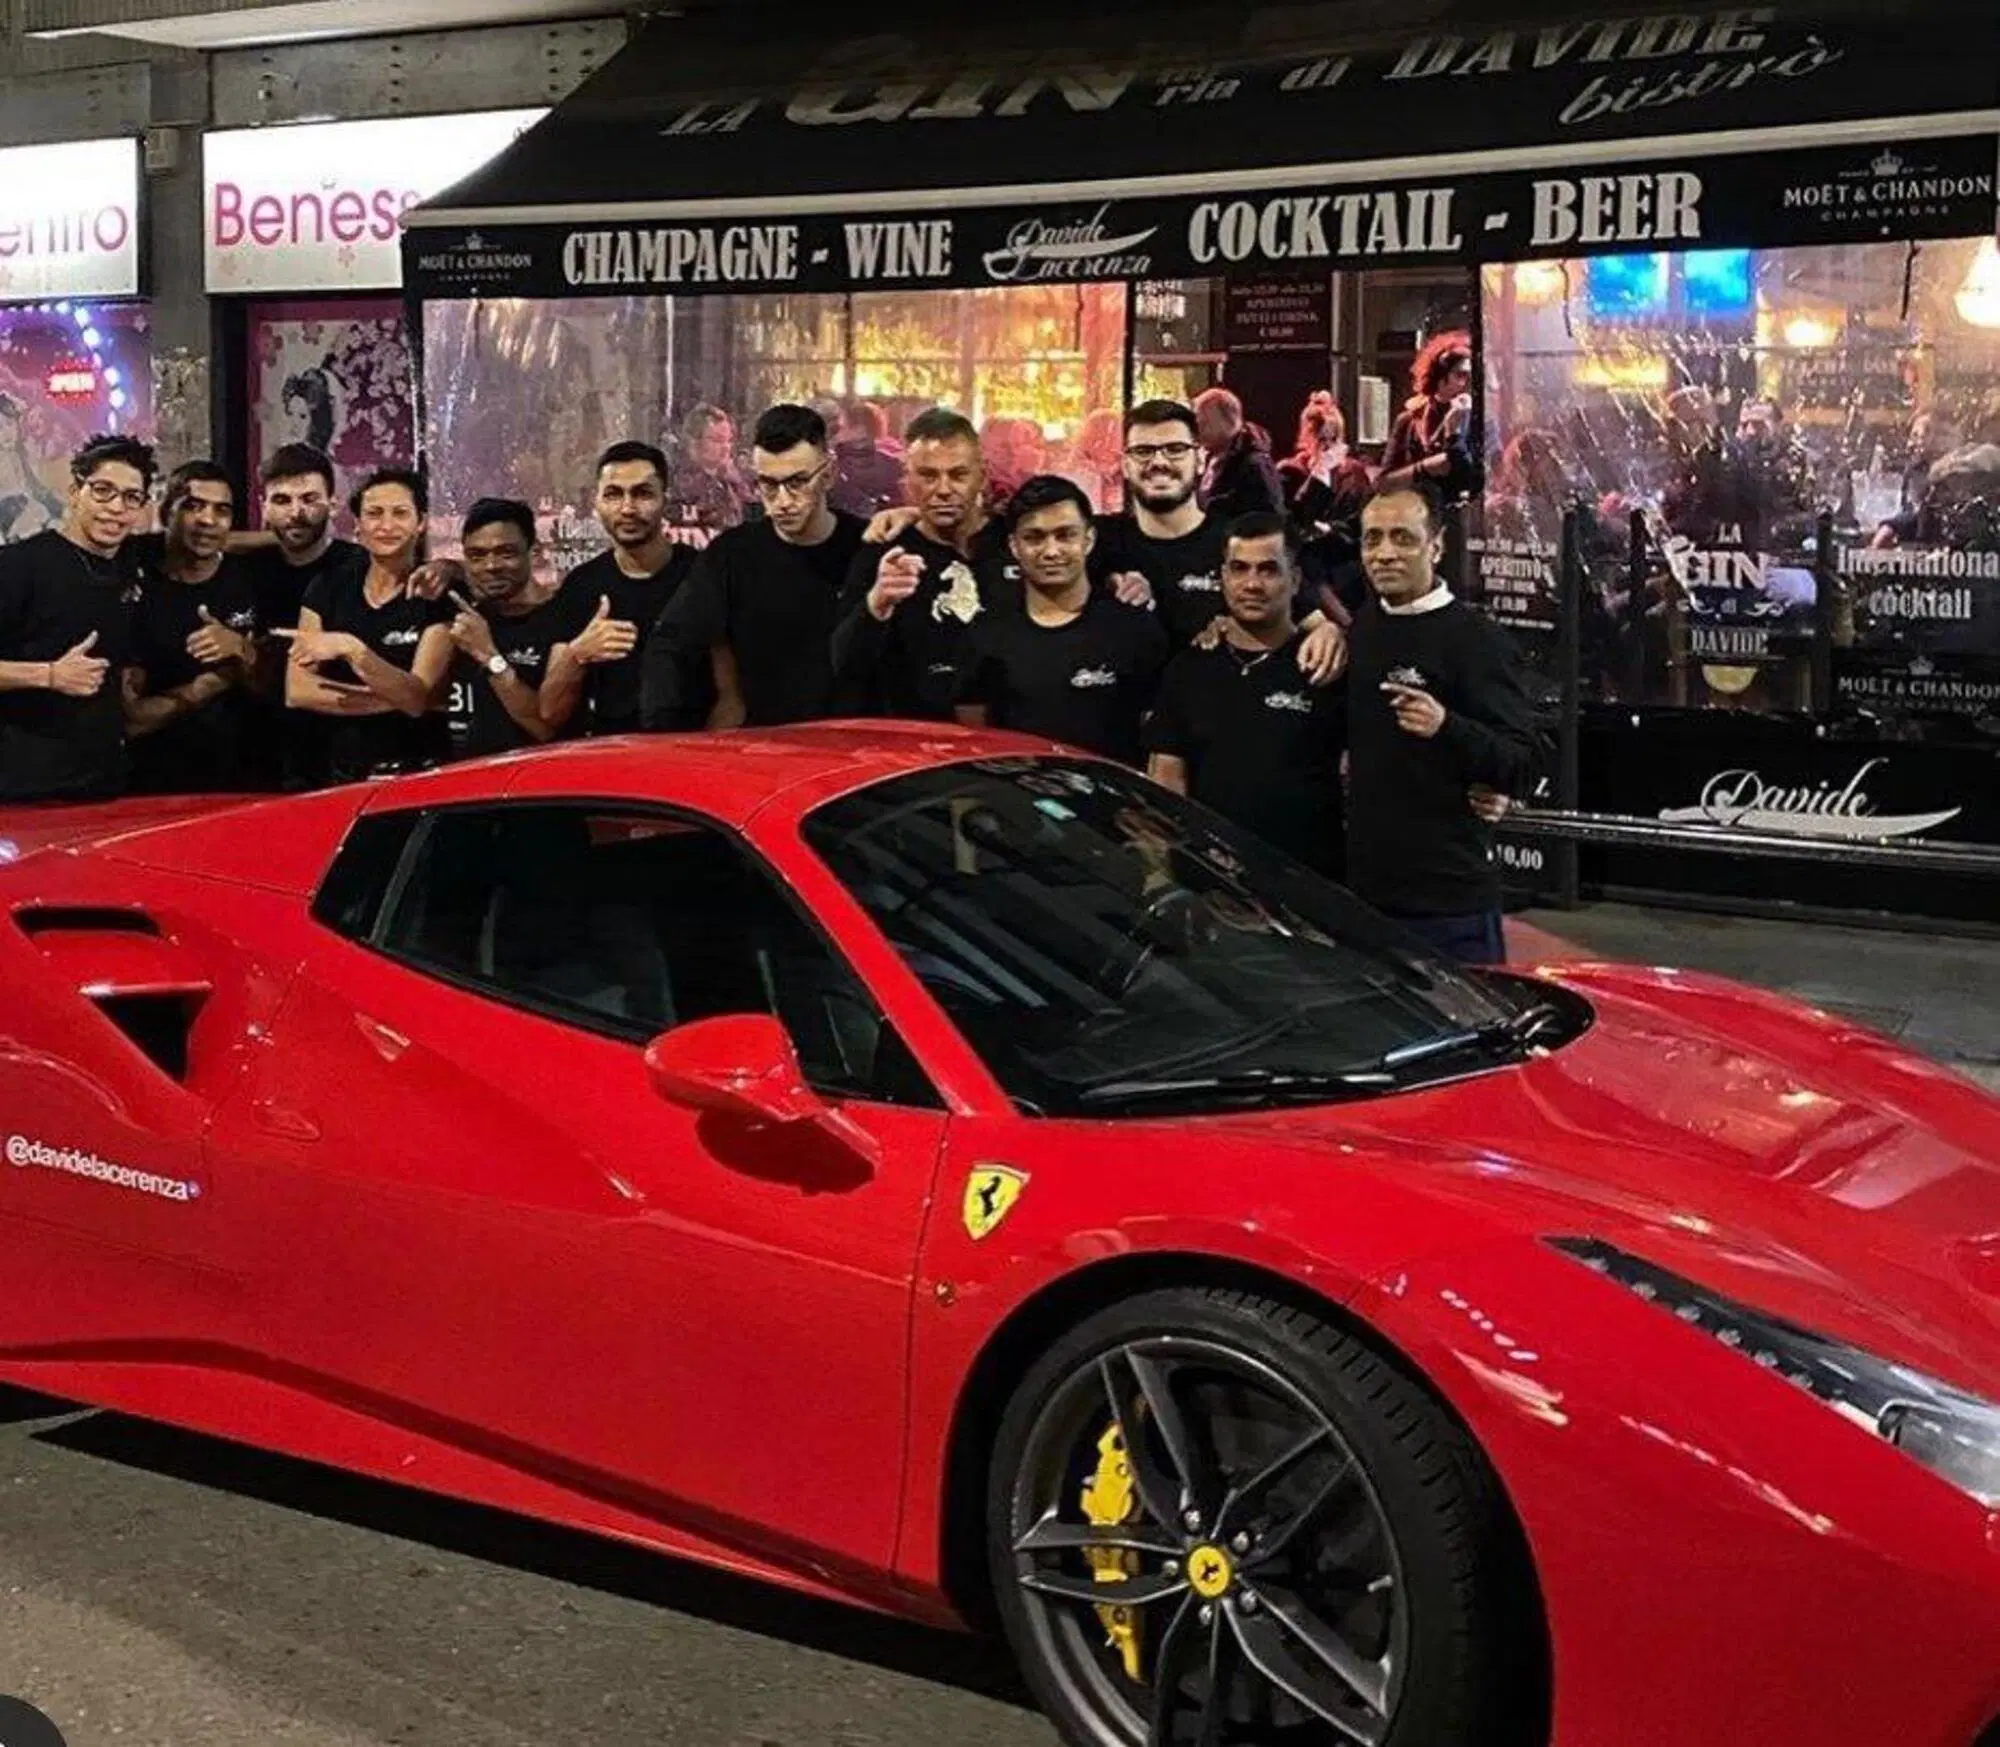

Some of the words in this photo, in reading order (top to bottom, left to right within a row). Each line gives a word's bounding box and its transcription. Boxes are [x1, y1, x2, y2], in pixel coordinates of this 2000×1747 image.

[1381, 8, 1775, 81] DAVIDE
[1557, 34, 1845, 125] bistrò
[1188, 187, 1463, 263] COCKTAIL
[1530, 171, 1703, 246] BEER
[1853, 186, 1867, 202] &
[1872, 174, 1992, 201] CHANDON
[563, 225, 799, 286] CHAMPAGNE
[843, 219, 953, 279] WINE
[1006, 201, 1112, 252] Davide
[1717, 522, 1742, 544] LA
[1674, 550, 1771, 590] GIN
[1691, 628, 1769, 654] DAVIDE
[1700, 757, 1890, 825] Davide
[6, 1136, 189, 1200] @davidelacerenza
